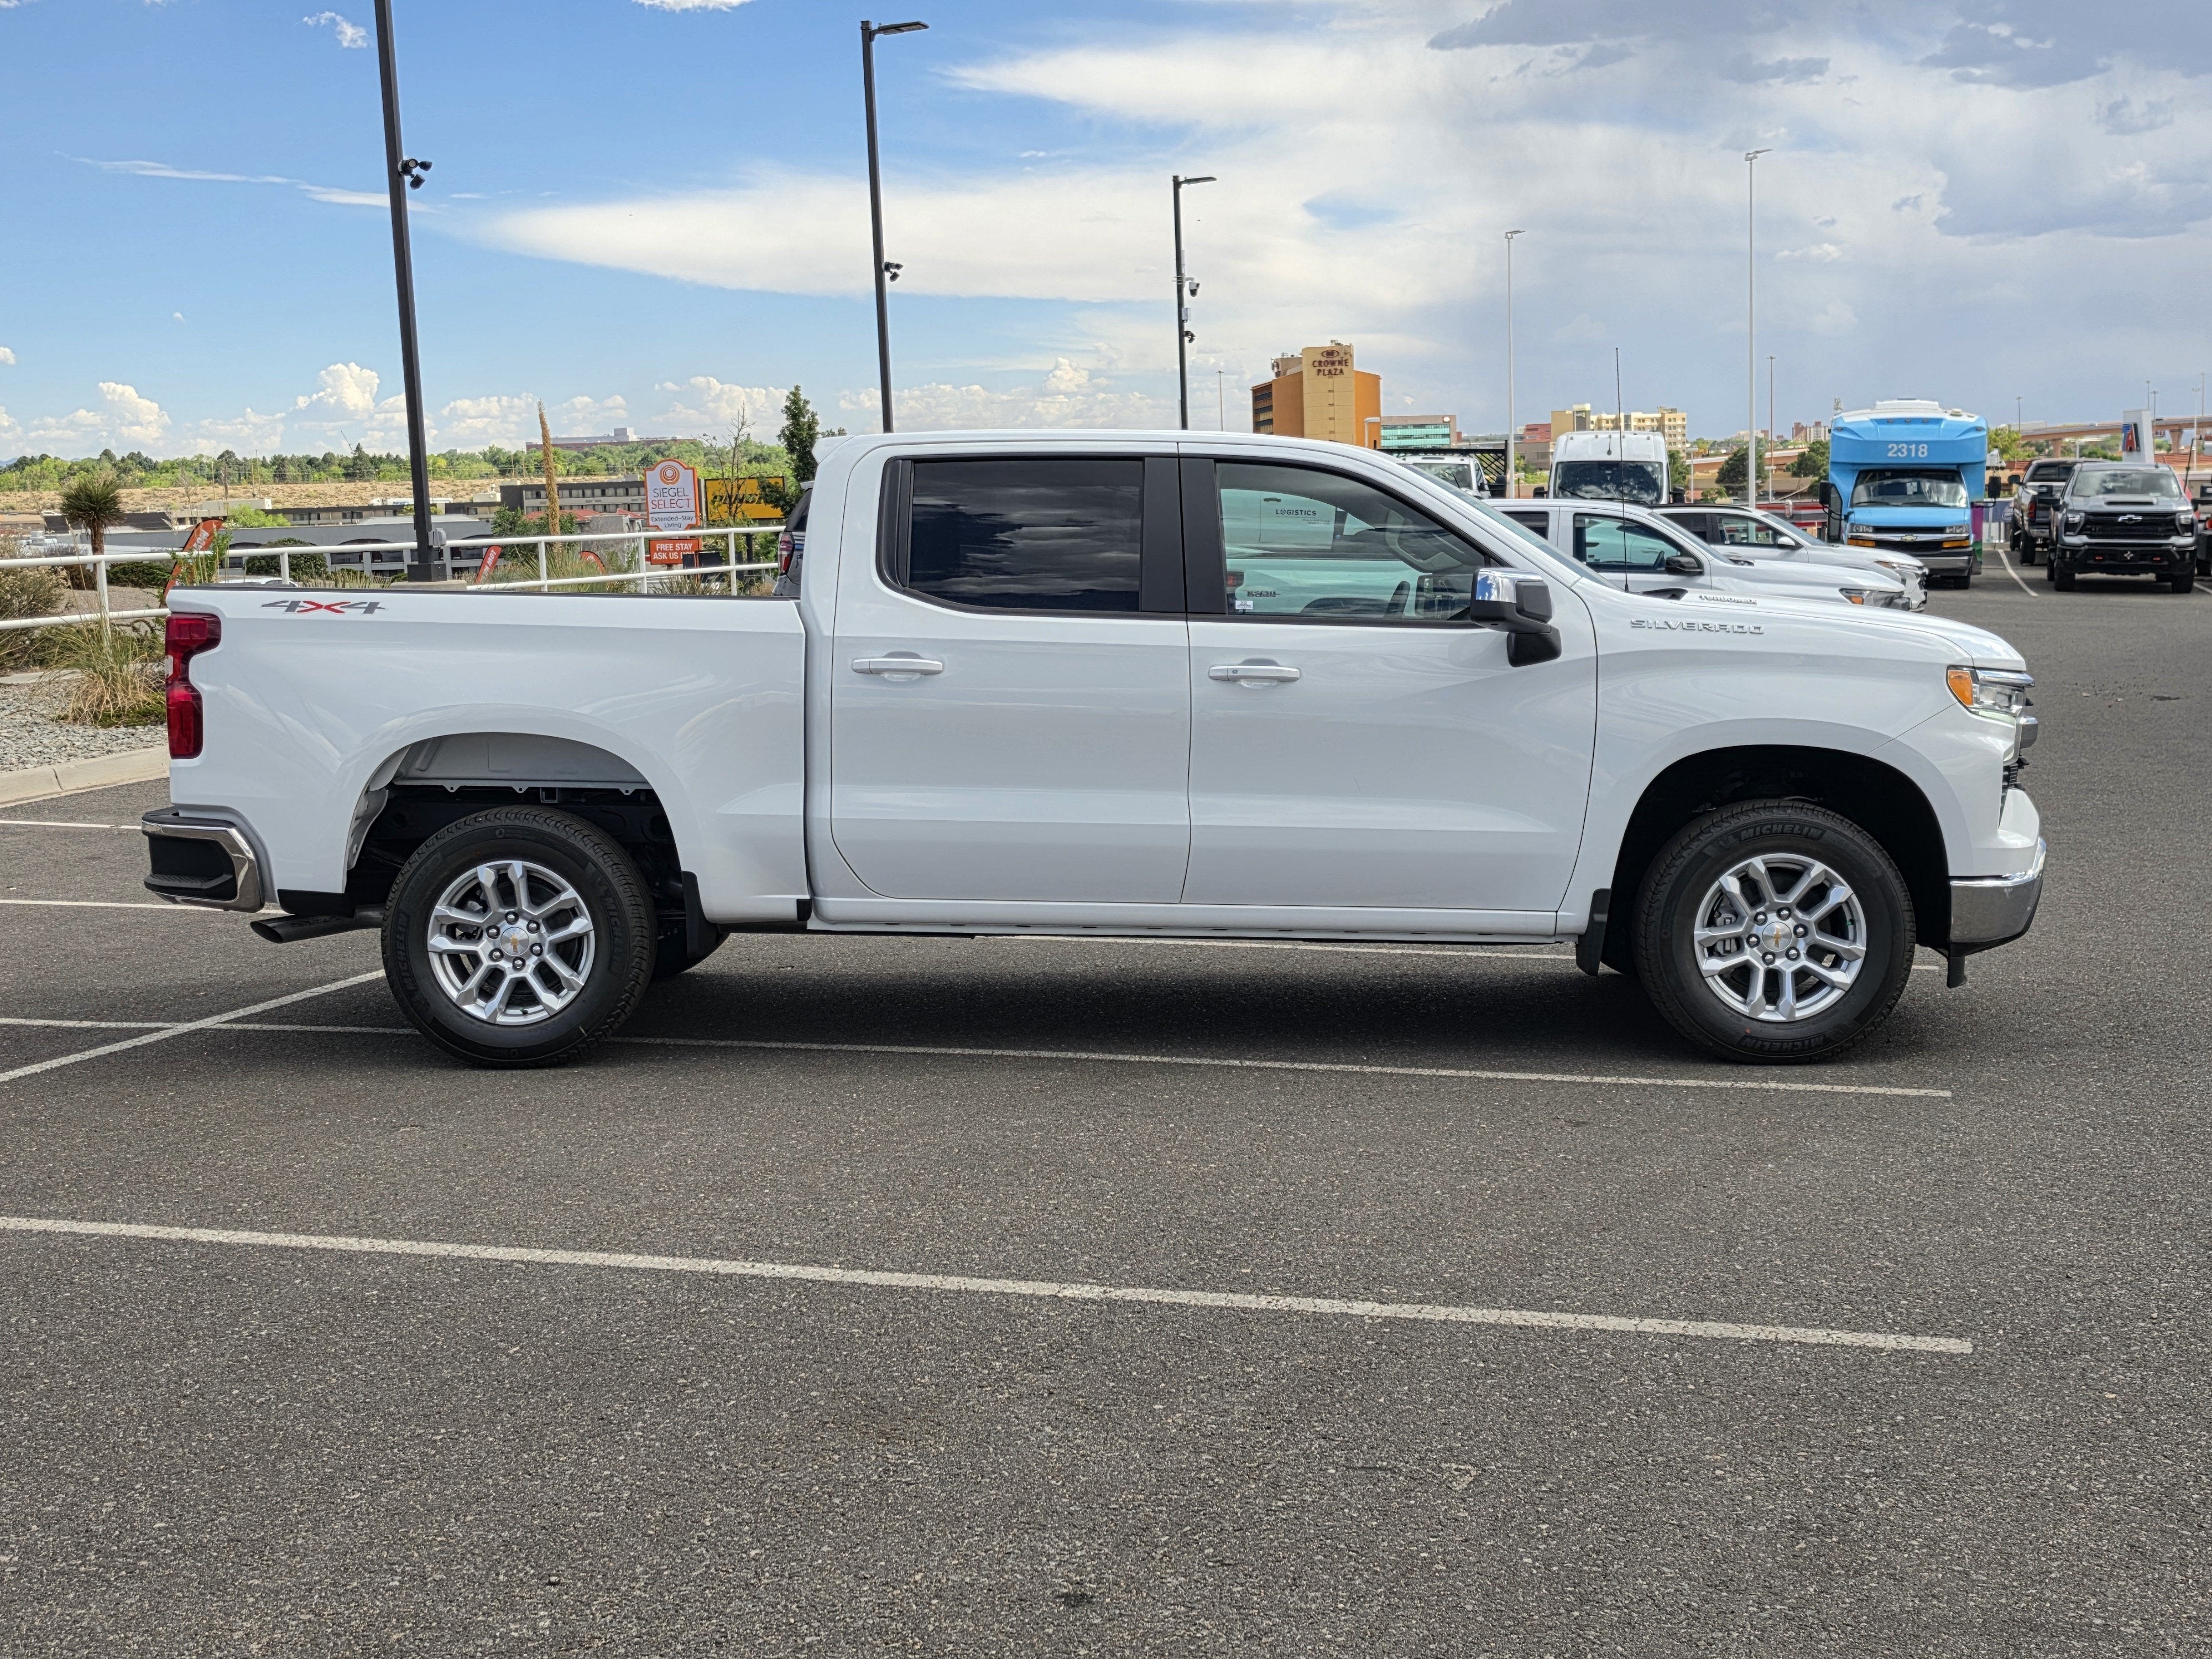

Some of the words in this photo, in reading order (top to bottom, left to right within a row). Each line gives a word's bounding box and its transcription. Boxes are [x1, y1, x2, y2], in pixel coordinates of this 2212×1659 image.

[1887, 443, 1928, 457] 2318
[653, 488, 689, 498] SIEGEL
[651, 499, 693, 509] SELECT
[669, 551, 679, 560] US
[1631, 620, 1764, 634] SILVERADO
[1741, 825, 1823, 840] MICHELIN
[396, 914, 415, 990] MICHELIN
